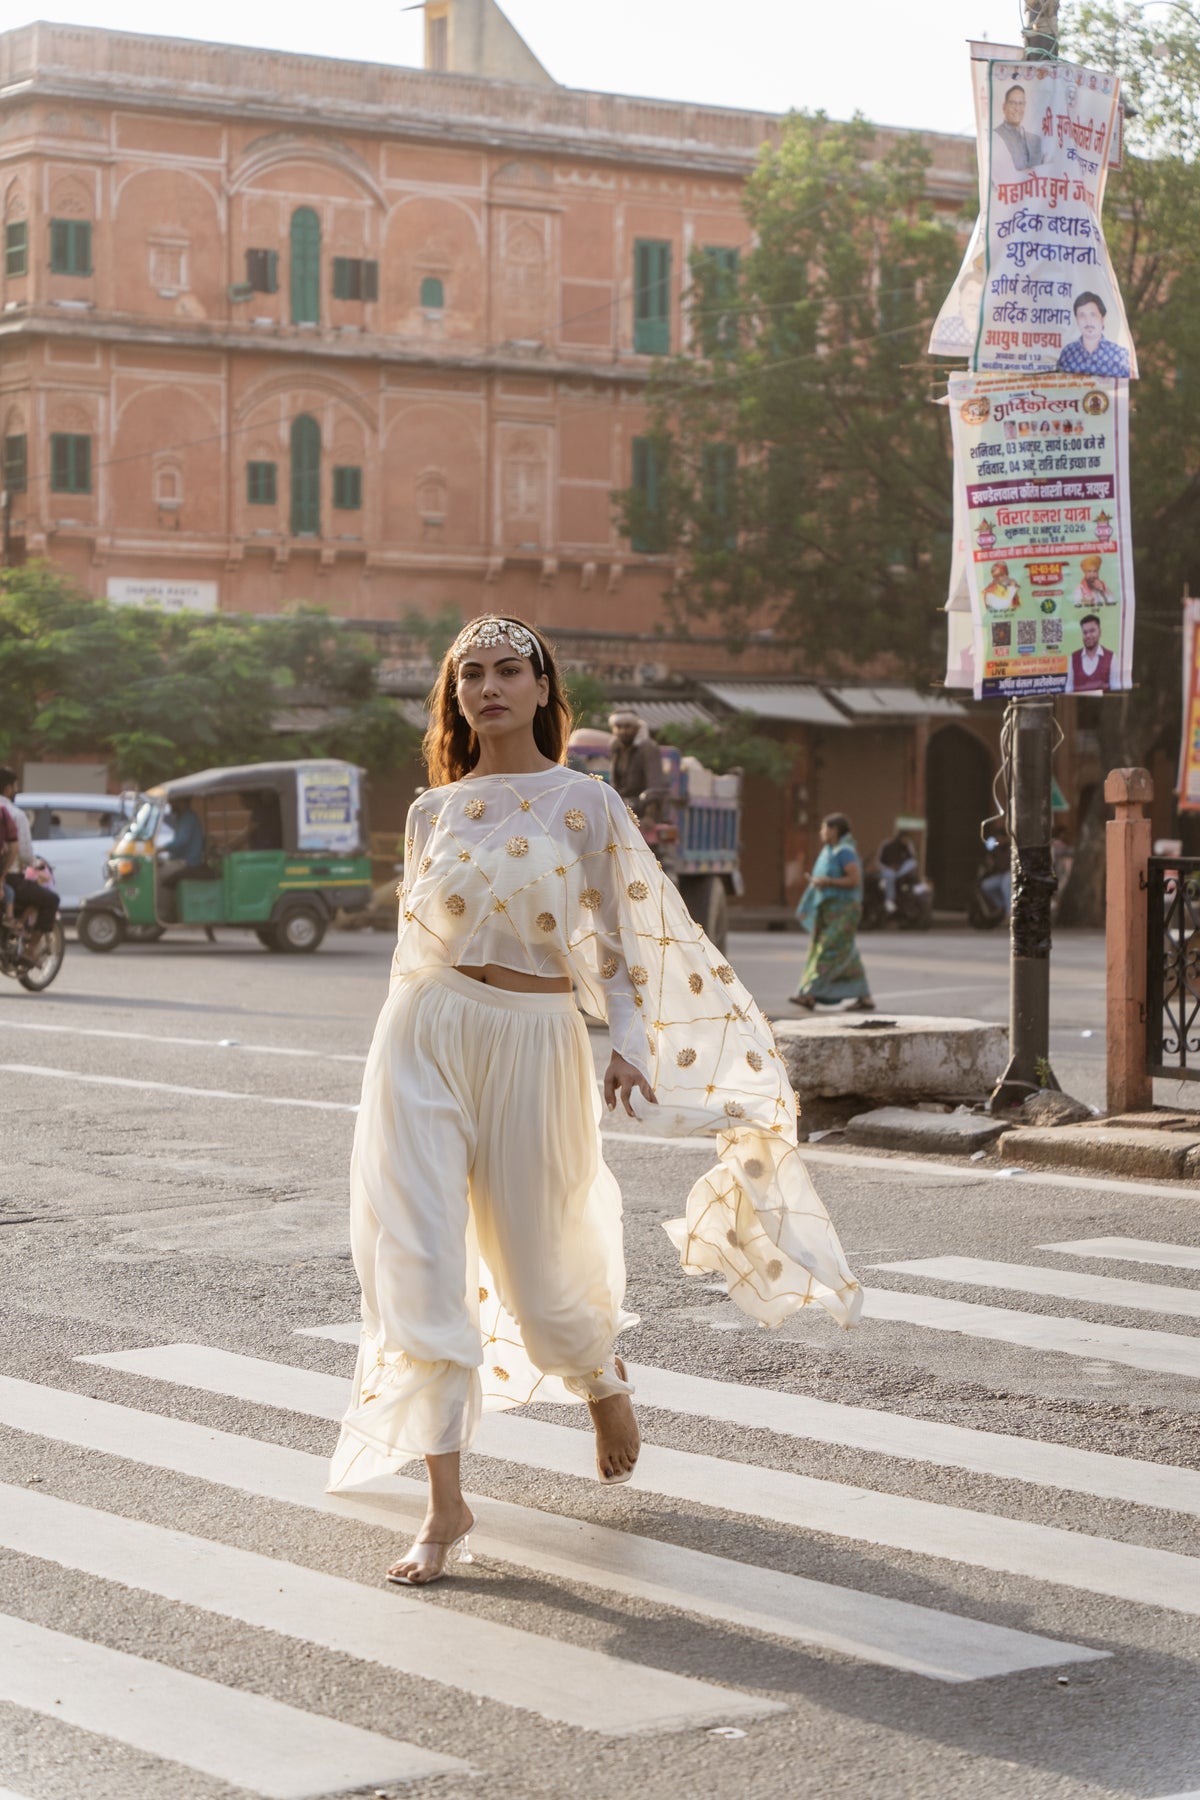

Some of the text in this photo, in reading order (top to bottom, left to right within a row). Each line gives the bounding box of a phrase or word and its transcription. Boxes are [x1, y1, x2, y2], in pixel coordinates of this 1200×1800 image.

[1057, 282, 1072, 298] का
[1006, 441, 1016, 454] 03
[1063, 438, 1082, 451] 6:00
[1009, 460, 1020, 473] 04
